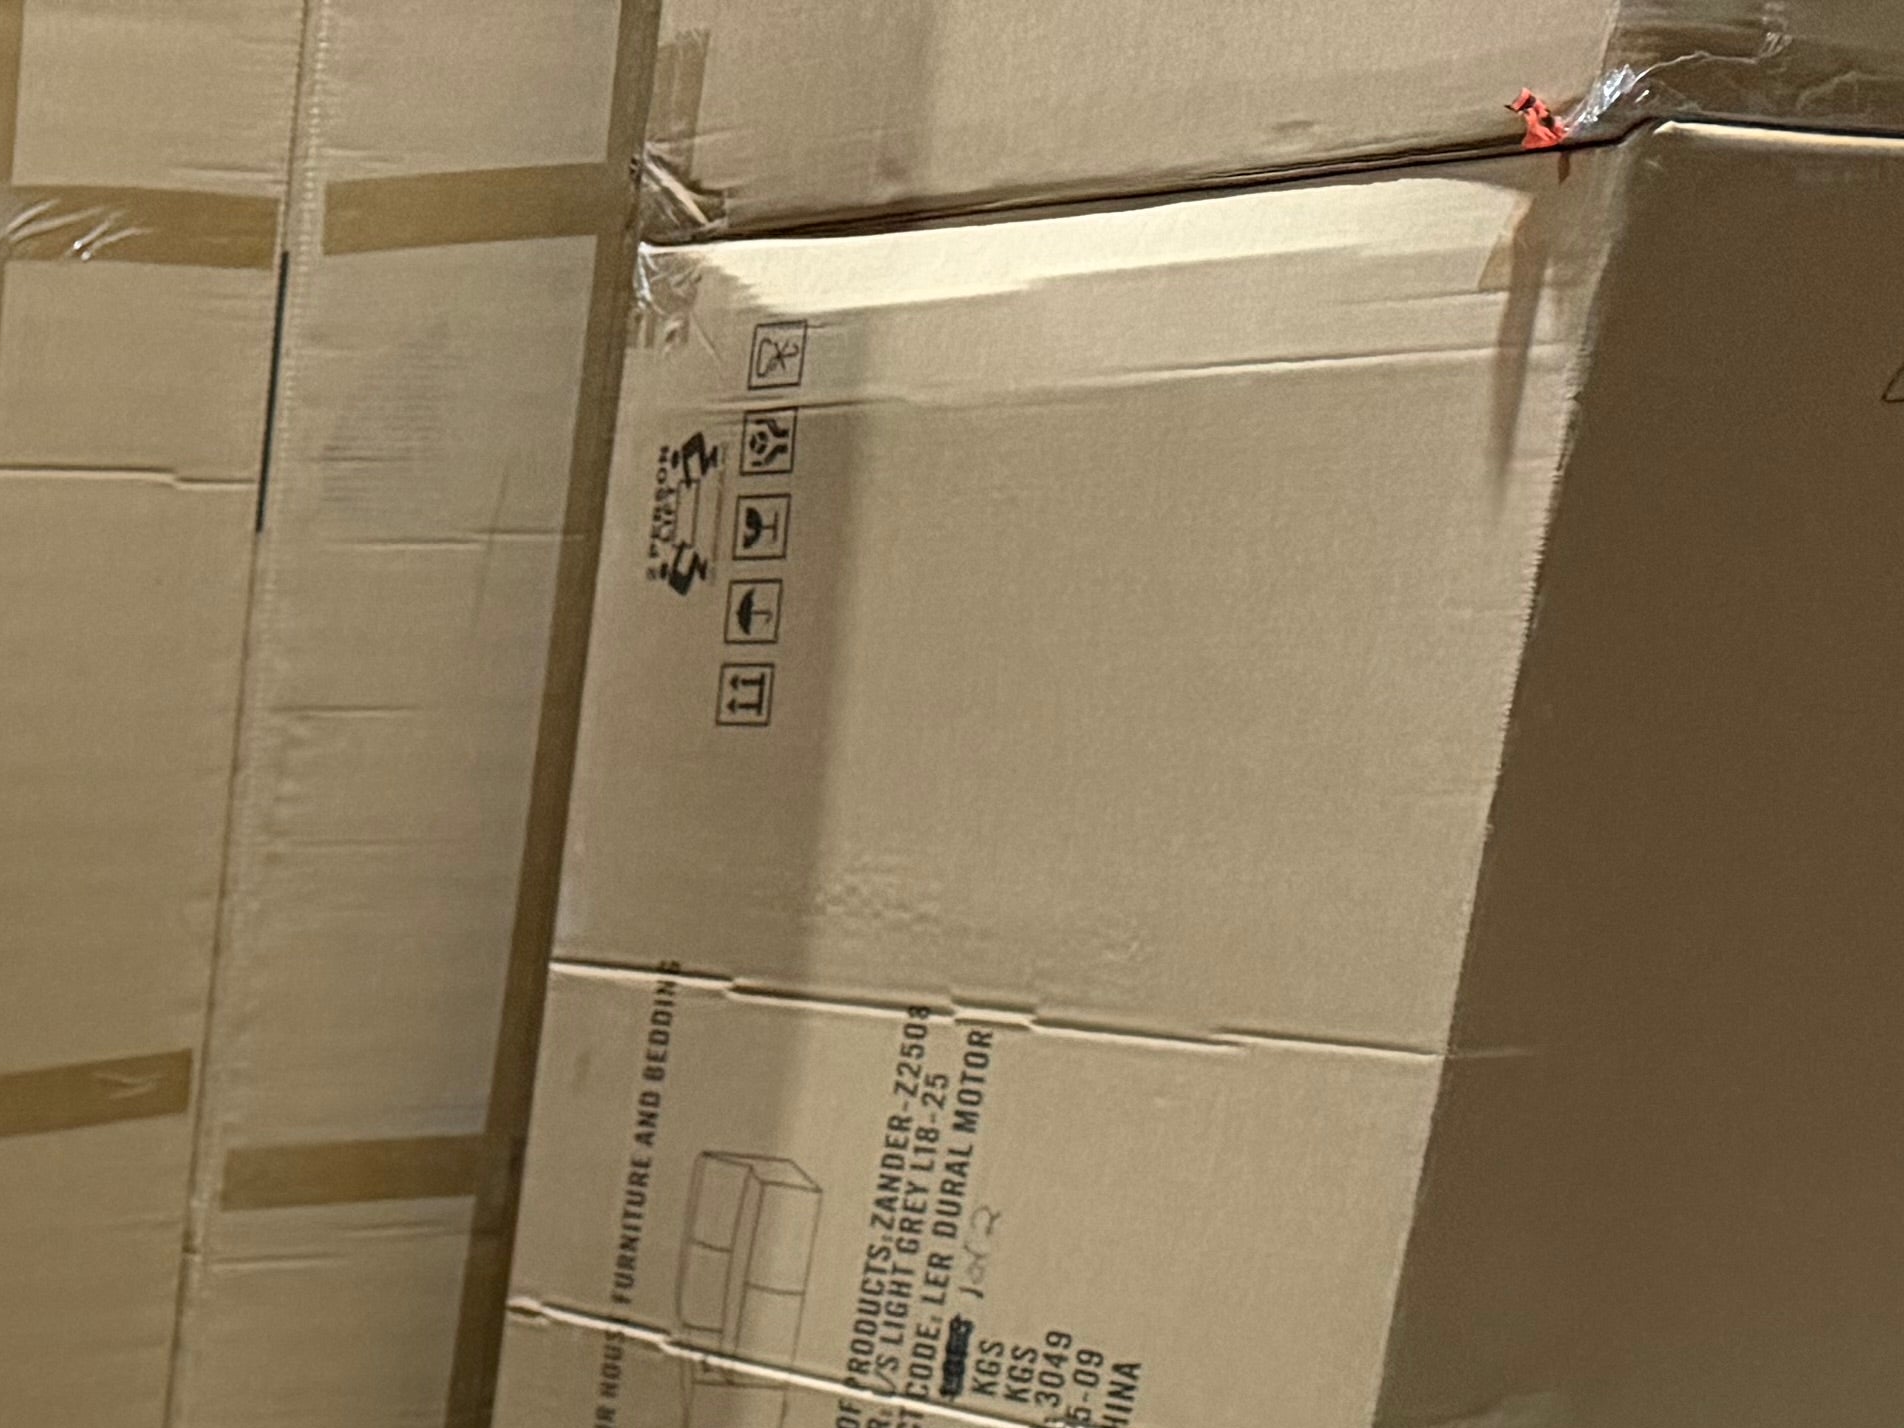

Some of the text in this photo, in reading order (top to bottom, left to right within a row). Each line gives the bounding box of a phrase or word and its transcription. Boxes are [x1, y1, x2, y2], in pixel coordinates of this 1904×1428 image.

[953, 1029, 992, 1135] MOTOR
[911, 1072, 949, 1174] L18-25
[612, 1157, 652, 1304] FURNITURE
[635, 1090, 661, 1147] AND
[896, 1178, 929, 1255] GREY
[932, 1143, 973, 1239] DURAL
[880, 1264, 916, 1347] LIGHT
[921, 1254, 954, 1306] LER
[972, 1339, 1005, 1397] KGS
[1003, 1344, 1038, 1404] KGS
[1035, 1330, 1073, 1408] 3049
